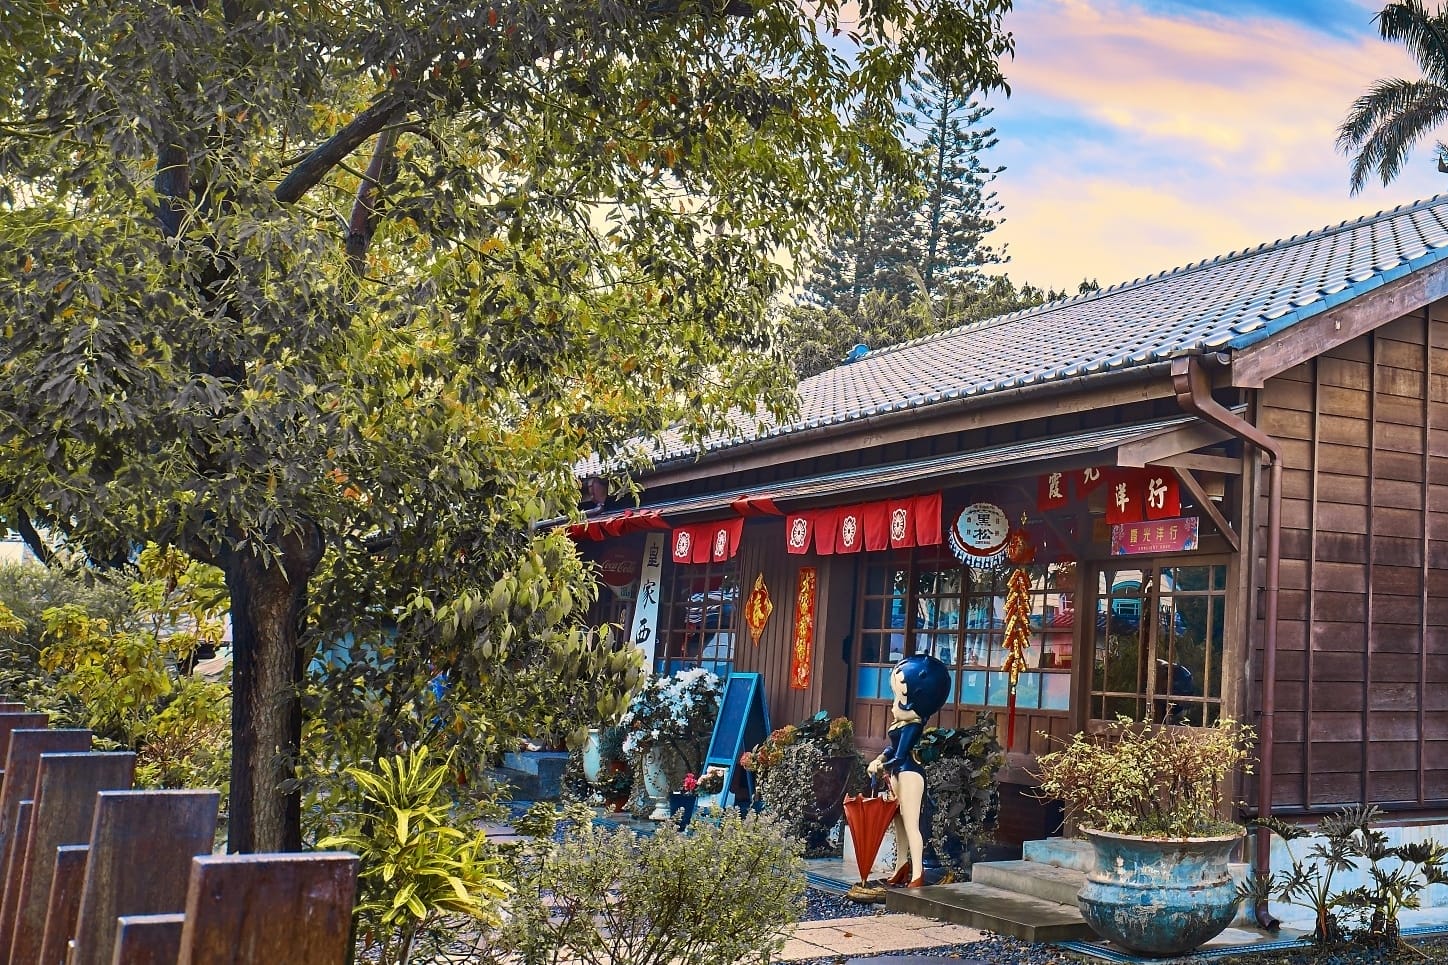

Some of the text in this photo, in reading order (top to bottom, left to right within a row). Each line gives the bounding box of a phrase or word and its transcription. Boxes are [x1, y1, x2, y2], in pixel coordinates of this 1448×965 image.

[972, 513, 994, 540] 黑松
[1129, 525, 1178, 543] 霞光洋行
[635, 542, 660, 661] 皇家西
